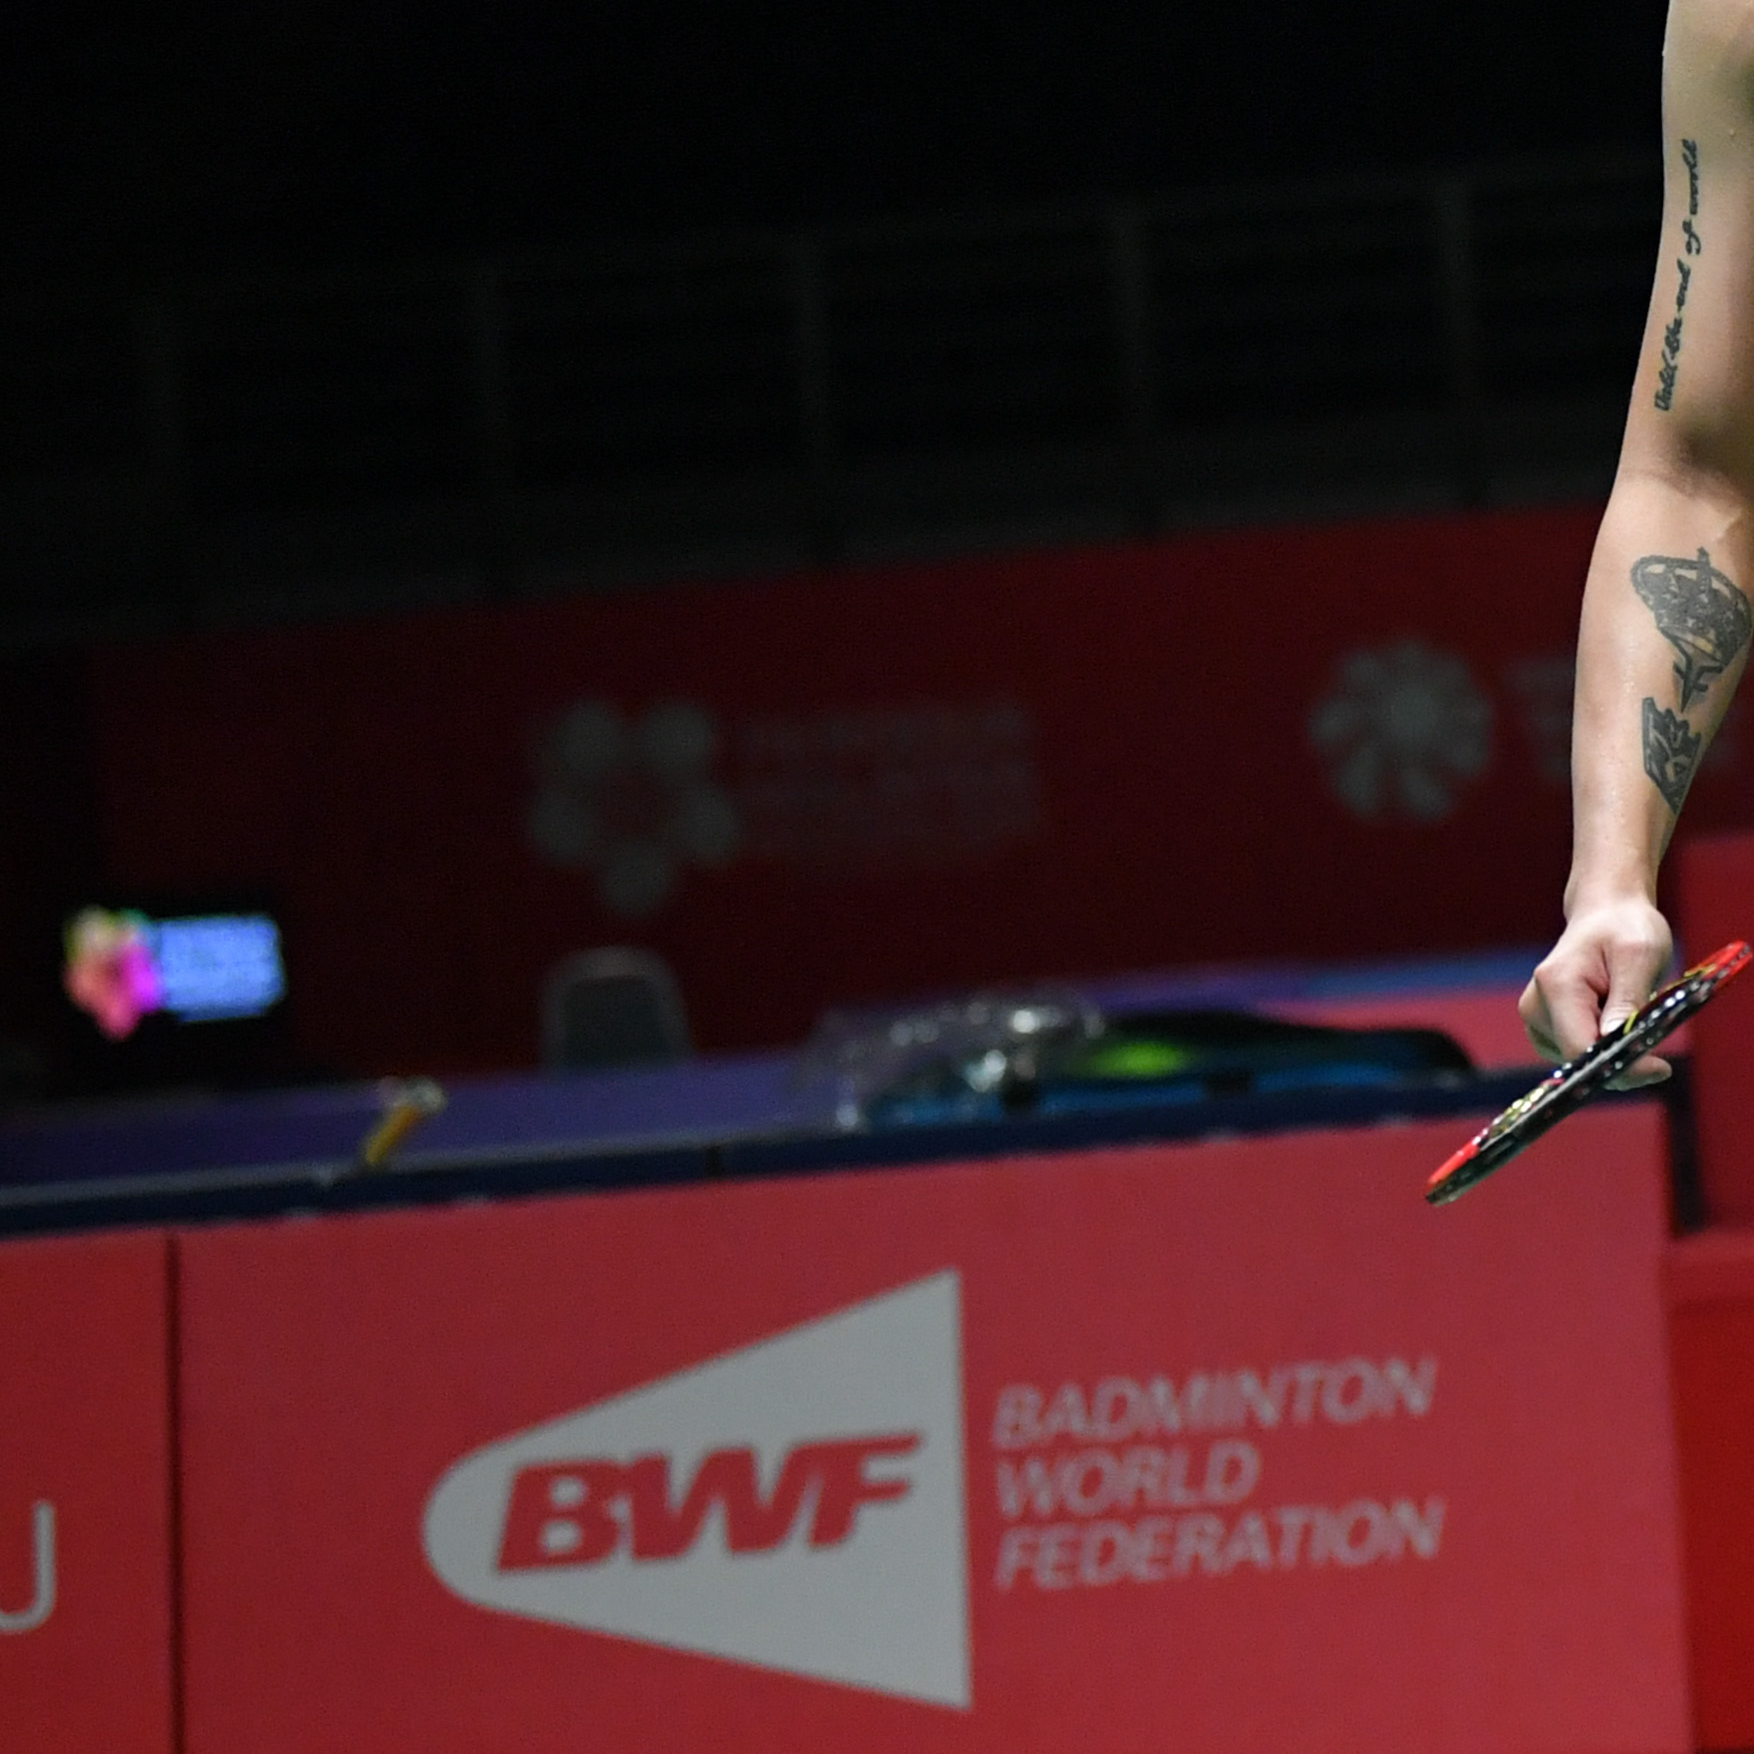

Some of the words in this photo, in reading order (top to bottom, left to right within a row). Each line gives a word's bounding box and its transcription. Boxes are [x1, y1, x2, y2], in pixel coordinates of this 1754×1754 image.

[1682, 219, 1701, 255] of
[994, 1358, 1438, 1448] BADMINTON
[498, 1432, 923, 1573] BWF
[998, 1440, 1262, 1521] WORLD
[994, 1496, 1447, 1592] FEDERATION
